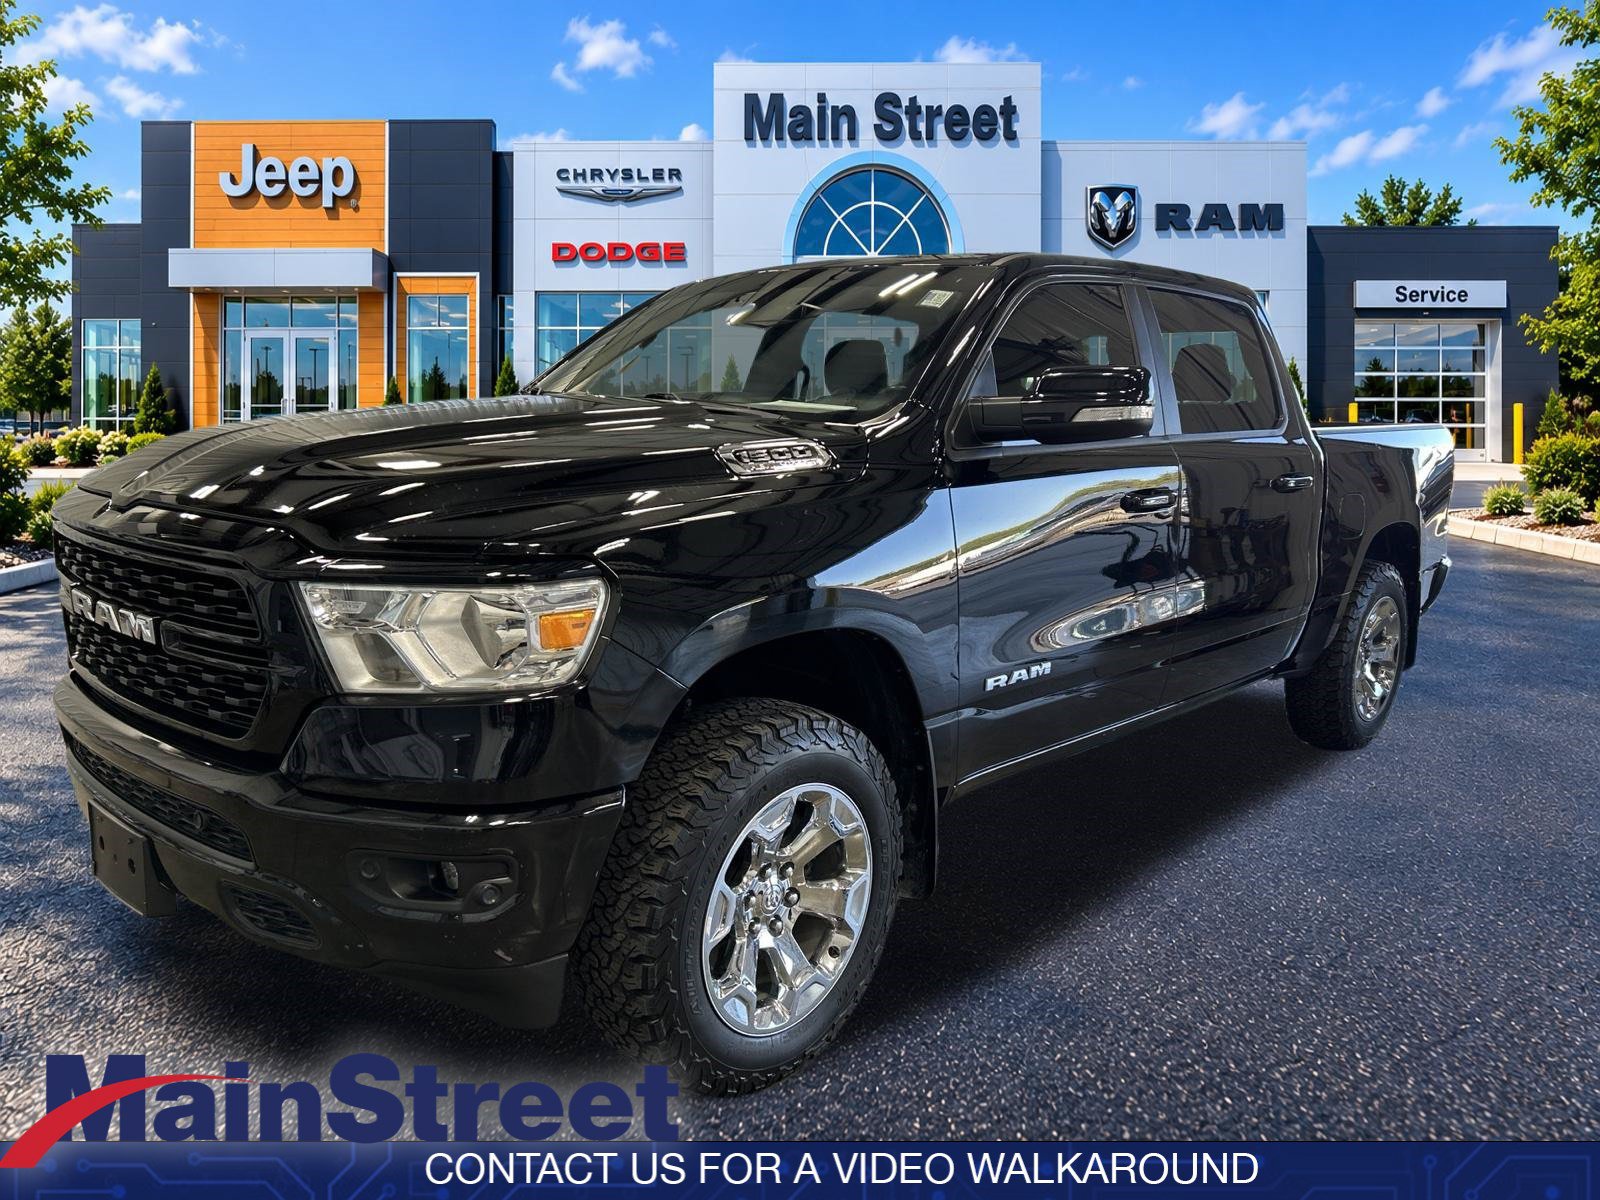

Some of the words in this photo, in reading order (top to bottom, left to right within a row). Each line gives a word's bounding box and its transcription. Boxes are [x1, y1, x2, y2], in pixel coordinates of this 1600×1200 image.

[744, 92, 856, 141] Main
[873, 91, 1017, 142] Street
[218, 143, 354, 208] Jeep
[556, 168, 682, 182] CHRYSLER
[1155, 203, 1284, 232] RAM
[551, 242, 686, 261] DODGE
[1395, 285, 1468, 303] Service
[71, 587, 157, 646] RAM
[984, 661, 1053, 692] RAM
